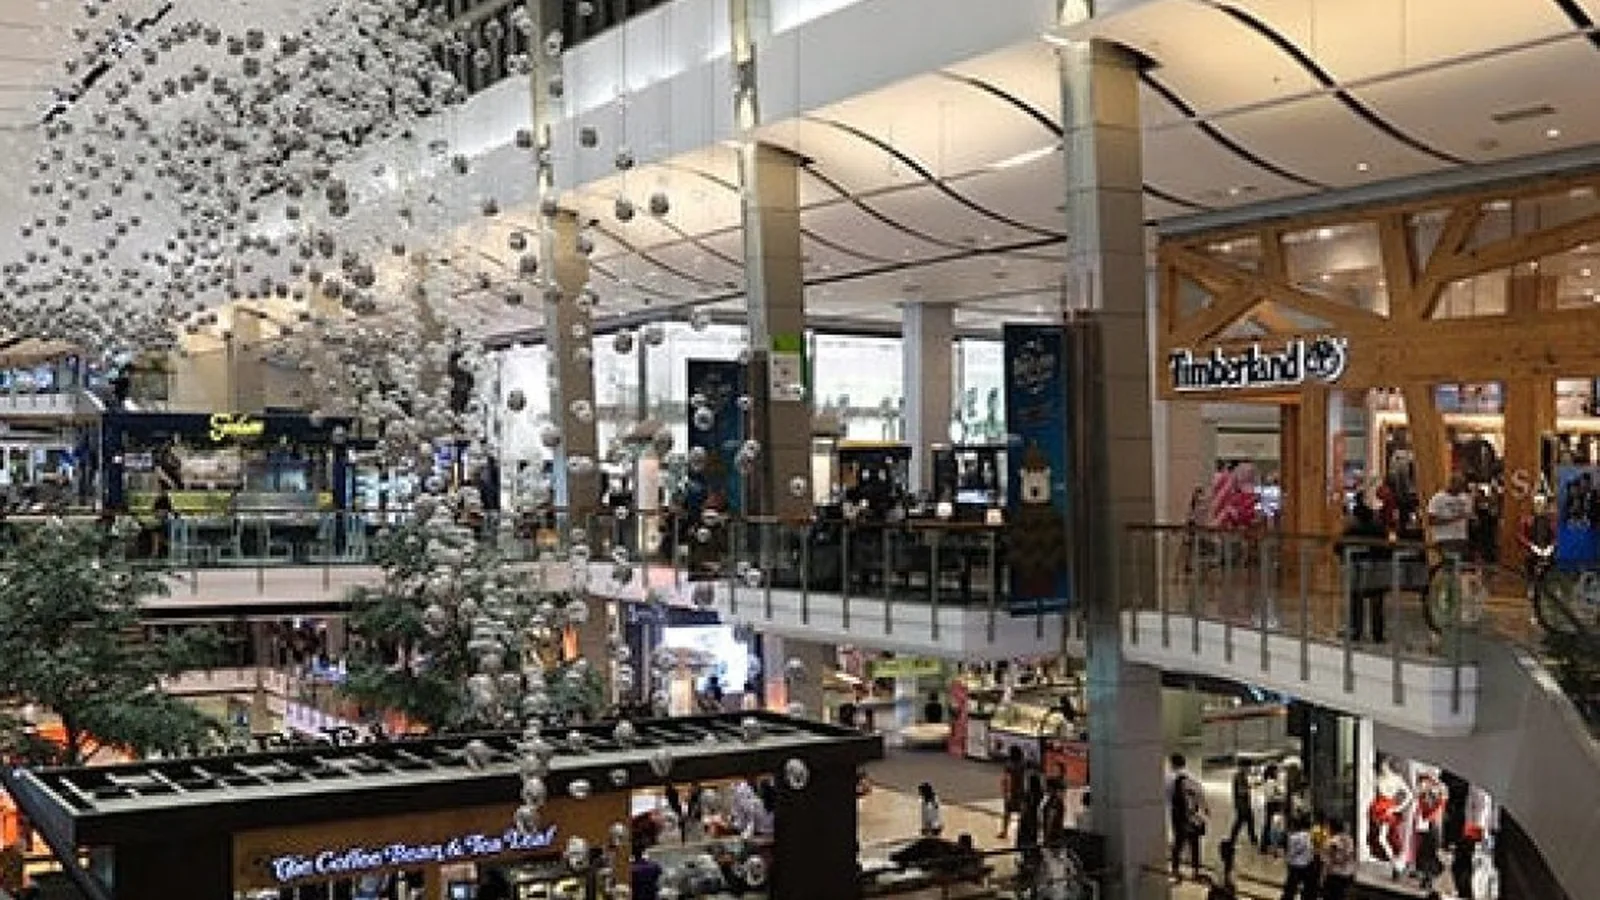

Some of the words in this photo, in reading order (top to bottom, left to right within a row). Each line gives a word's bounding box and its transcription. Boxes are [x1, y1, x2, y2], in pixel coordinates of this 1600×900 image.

[1170, 342, 1303, 390] Timberland
[273, 856, 313, 881] The
[315, 850, 381, 873] Coffee
[383, 844, 444, 864] Bean
[447, 838, 465, 856] &
[464, 834, 501, 855] Tea
[503, 825, 557, 849] Leaf
